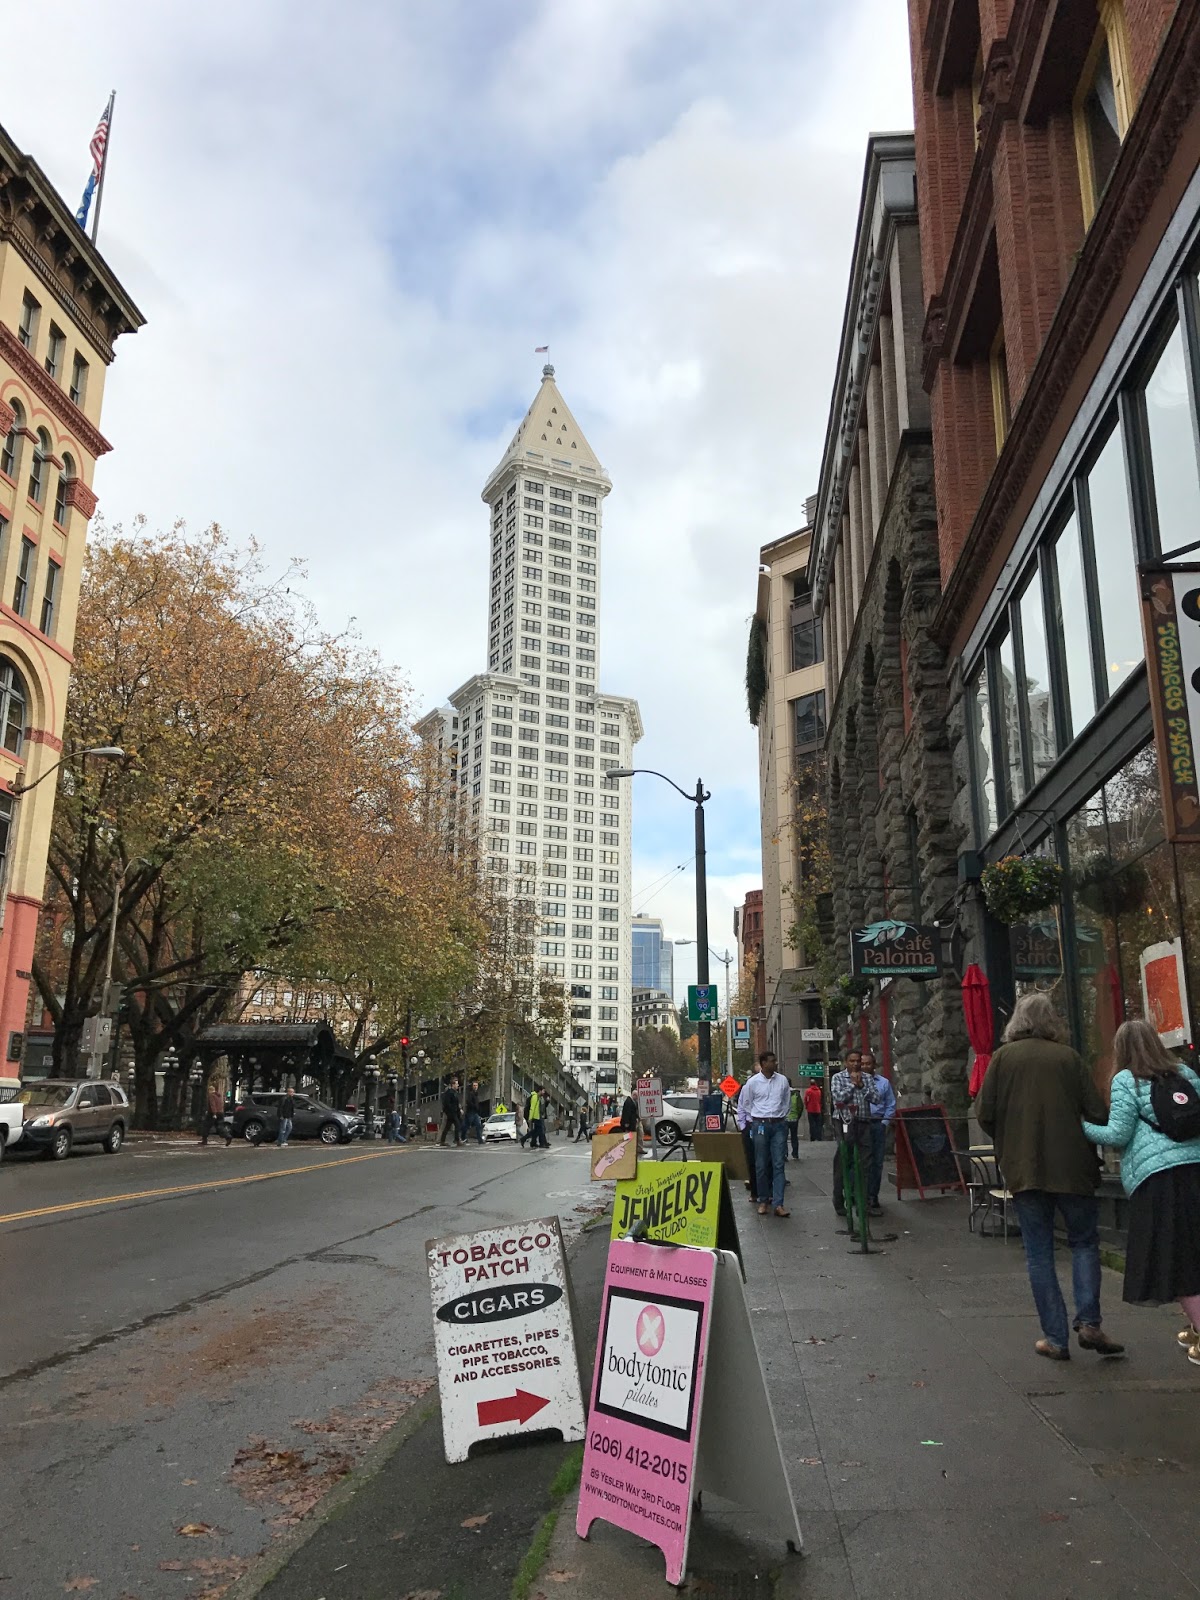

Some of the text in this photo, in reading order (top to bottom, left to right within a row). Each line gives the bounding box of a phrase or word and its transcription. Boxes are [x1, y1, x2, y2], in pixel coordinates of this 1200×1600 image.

[894, 934, 931, 951] Café
[863, 947, 935, 965] Paloma
[639, 1079, 650, 1088] NO
[645, 1105, 658, 1113] TIME
[619, 1170, 713, 1230] JEWELRY
[653, 1216, 688, 1240] STUDIO
[437, 1233, 551, 1267] TOBACCO
[464, 1256, 529, 1283] PATCH
[649, 1269, 656, 1279] &
[454, 1289, 546, 1319] CIGARS
[448, 1328, 559, 1357] CIGARETTES, PIPES
[462, 1345, 548, 1368] PIPE TOBACCO,
[608, 1345, 687, 1391] bodytonic
[453, 1356, 560, 1383] AND ACCESSORIES
[622, 1384, 658, 1408] pilates
[590, 1431, 688, 1484] (206) 412-2015
[590, 1468, 600, 1480] 89
